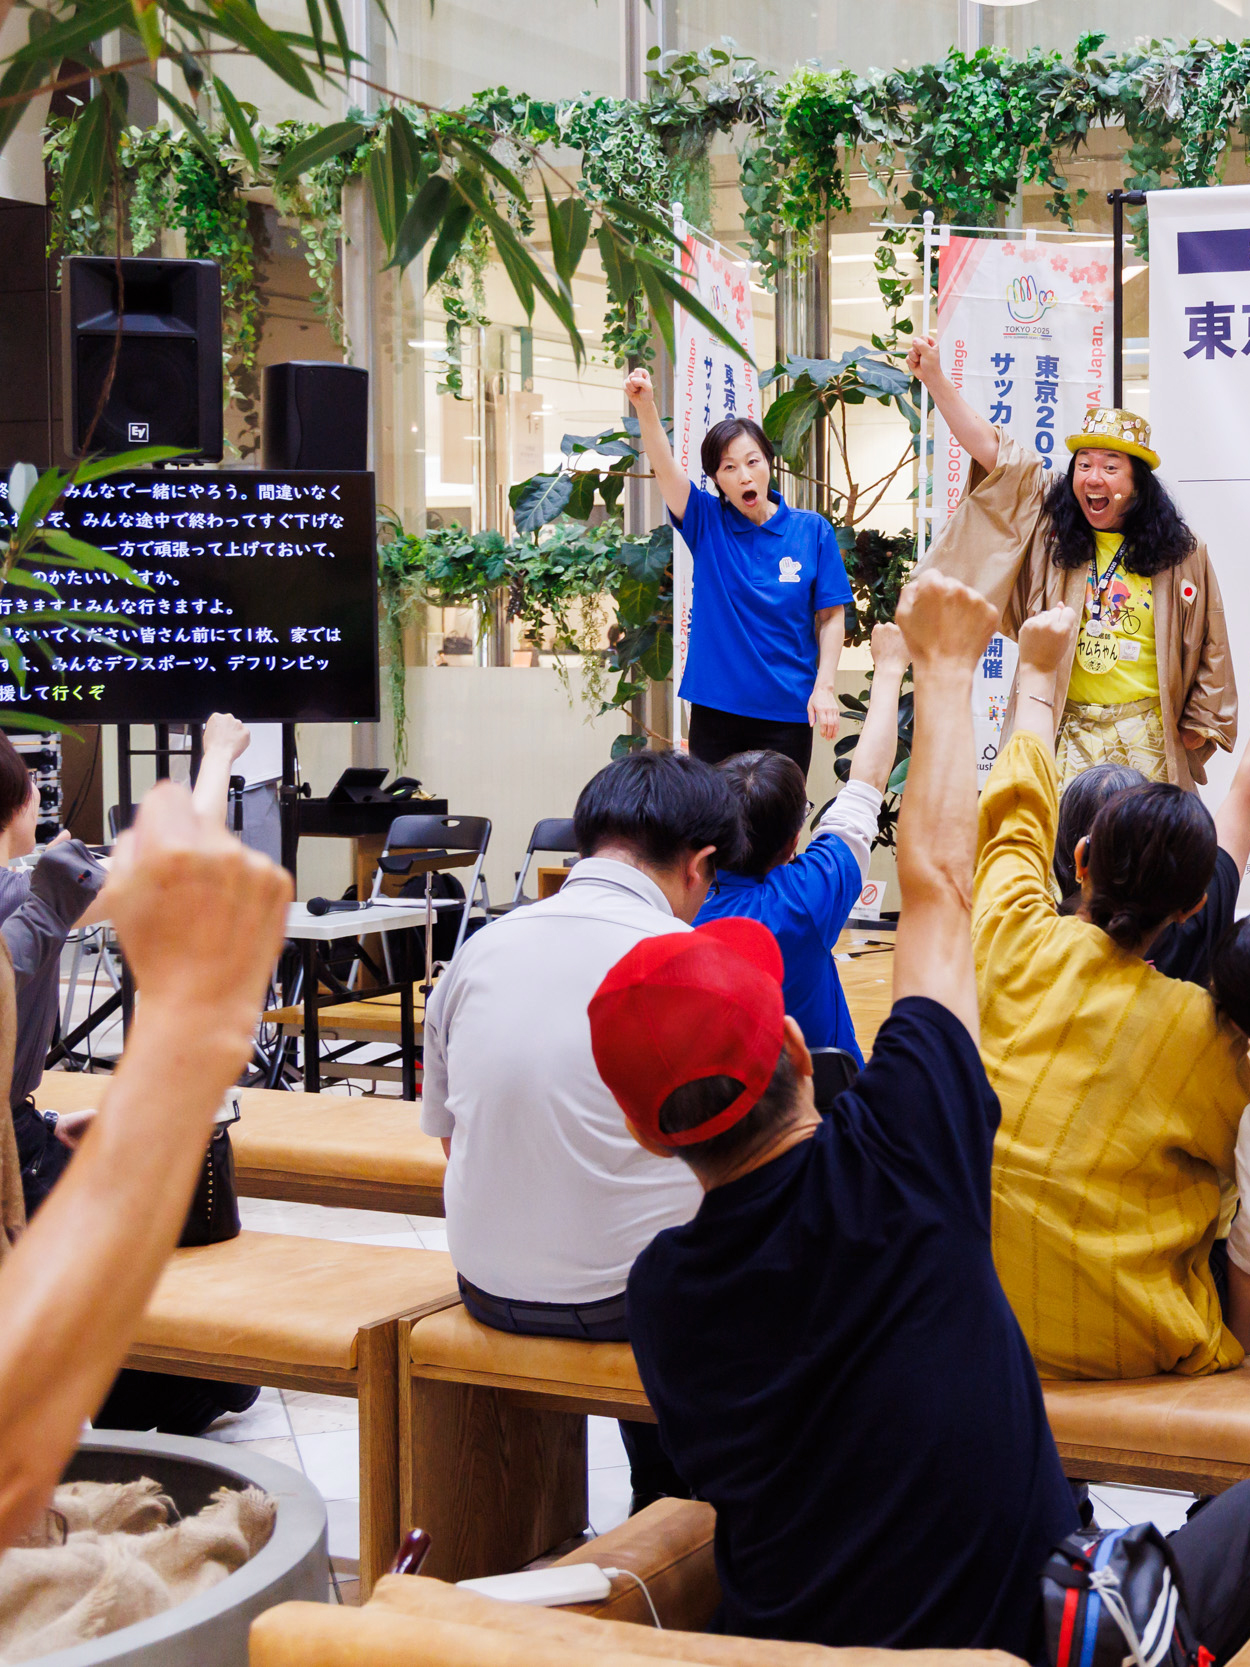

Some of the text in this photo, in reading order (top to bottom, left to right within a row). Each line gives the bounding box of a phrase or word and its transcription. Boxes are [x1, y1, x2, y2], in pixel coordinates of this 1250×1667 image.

[1004, 325, 1050, 335] TOKYO 2025
[1087, 320, 1106, 379] Japan.
